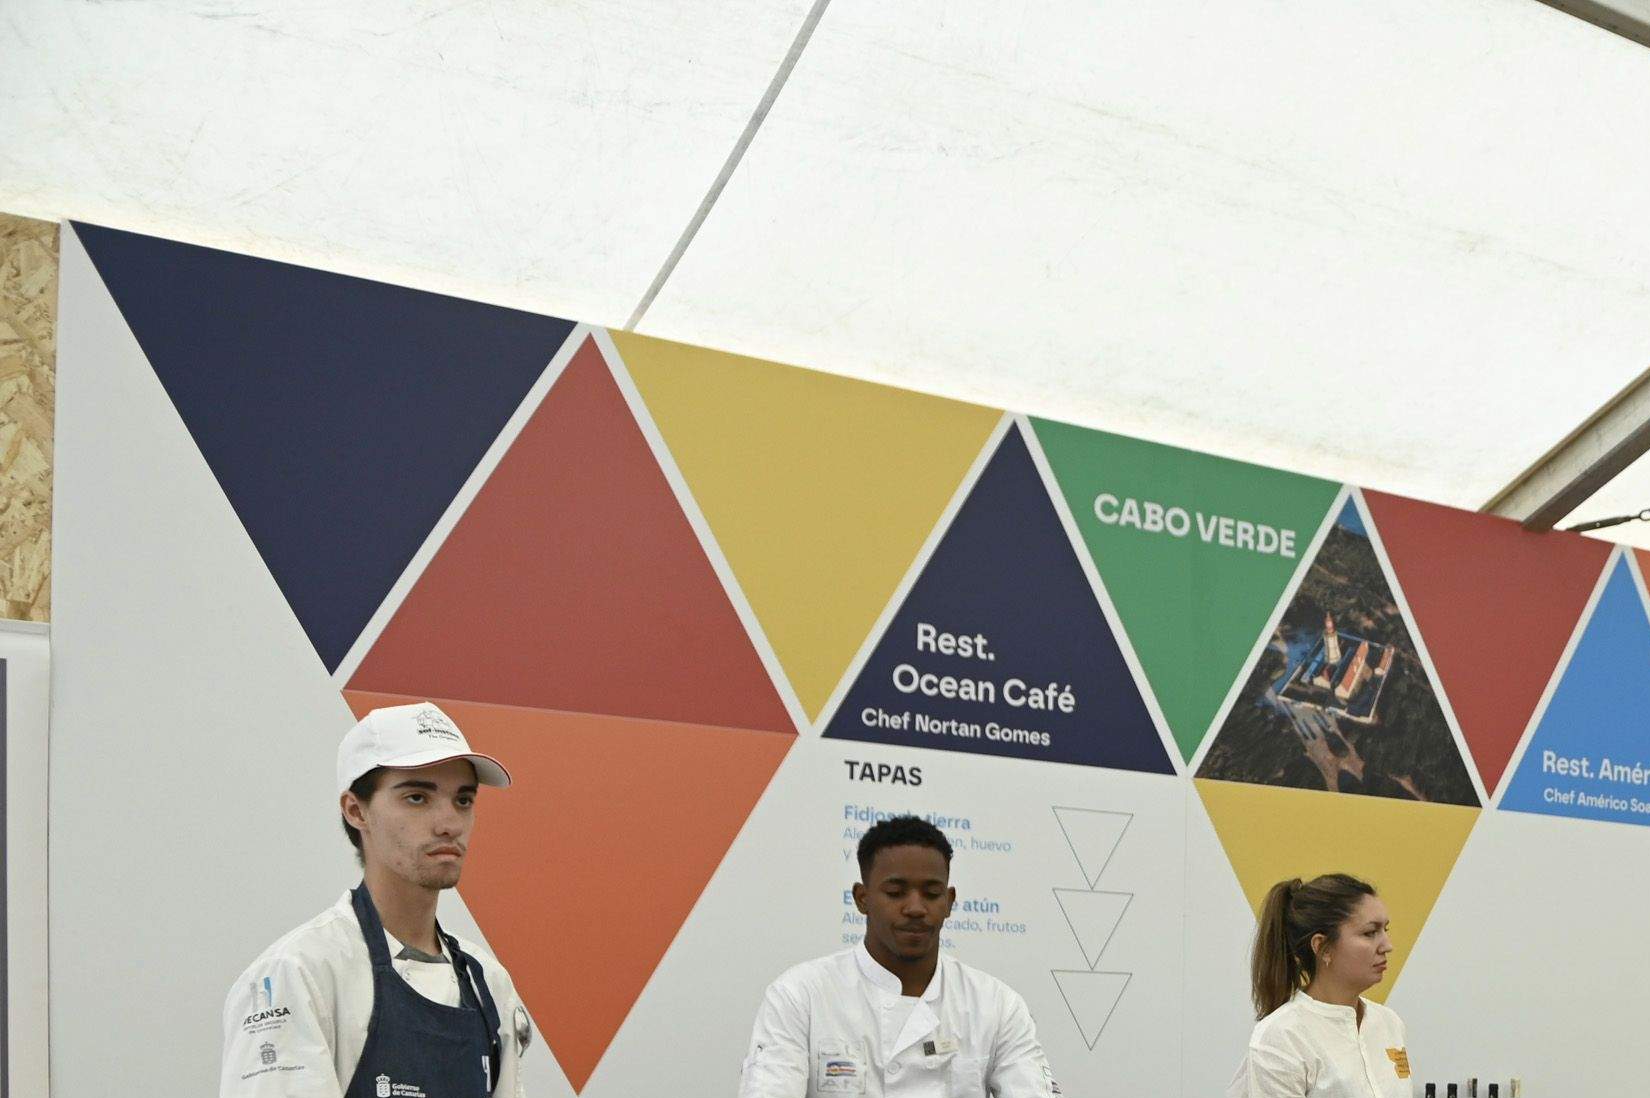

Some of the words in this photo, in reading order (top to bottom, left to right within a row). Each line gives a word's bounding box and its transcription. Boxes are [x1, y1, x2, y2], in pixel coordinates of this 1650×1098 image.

[1094, 493, 1191, 537] CABO
[1196, 512, 1296, 558] VERDE
[917, 622, 995, 661] Rest.
[892, 663, 995, 703] Ocean
[1003, 678, 1076, 713] Café
[861, 708, 911, 730] Chef
[915, 715, 981, 738] Nortan
[985, 723, 1050, 746] Gomes
[844, 760, 923, 786] TAPAS
[1543, 750, 1594, 778] Rest.
[1544, 788, 1575, 804] Chef
[1577, 792, 1628, 811] Américo
[970, 836, 1012, 852] huevo
[963, 897, 1000, 914] atún
[986, 917, 1026, 933] frutos
